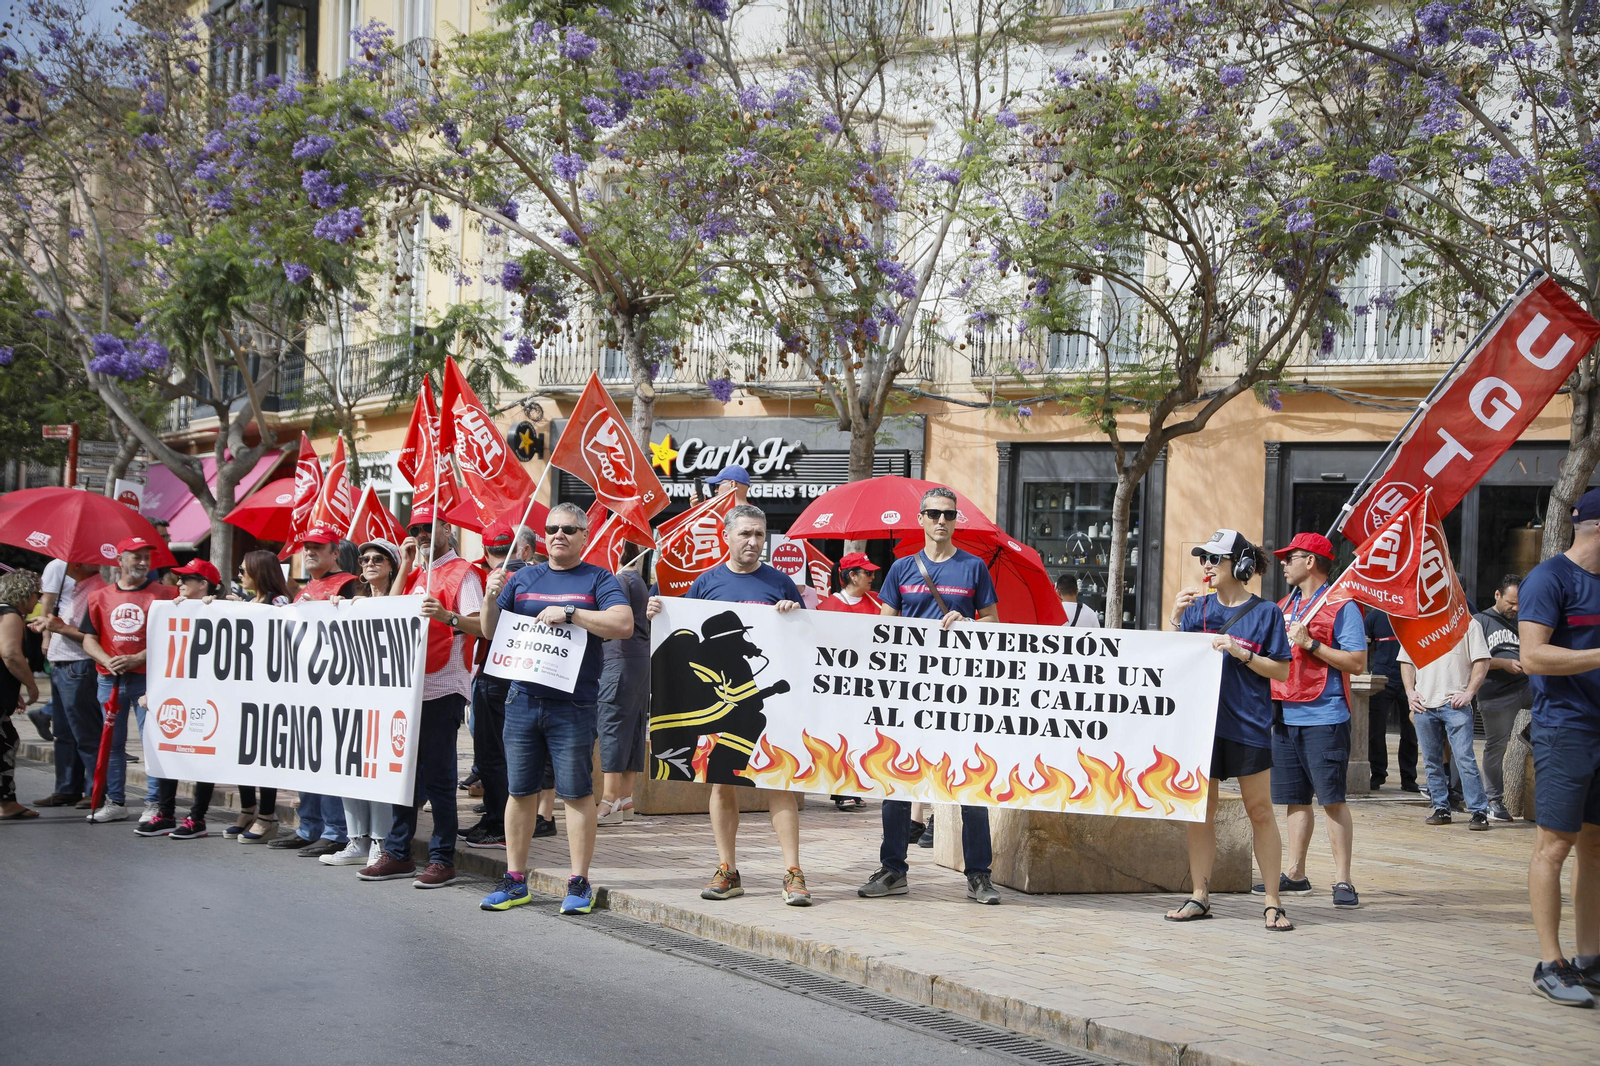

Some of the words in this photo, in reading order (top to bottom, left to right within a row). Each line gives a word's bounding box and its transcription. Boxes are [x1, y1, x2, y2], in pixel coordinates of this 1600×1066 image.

[462, 410, 503, 463] UGT
[676, 435, 754, 474] Carl's
[752, 437, 795, 475] Jr.
[799, 484, 837, 498] 194
[690, 517, 722, 561] UGT
[1339, 580, 1404, 605] www.ugt.es
[115, 608, 140, 620] UGT
[512, 621, 572, 641] JORNADA
[1417, 604, 1465, 649] www.ugt.es
[267, 617, 309, 684] UN
[506, 638, 521, 650] 35
[523, 641, 569, 658] HORAS
[873, 623, 928, 648] SIN
[938, 628, 1121, 658] INVERSIÓN
[492, 651, 522, 668] UGT
[816, 646, 858, 669] NO
[869, 650, 907, 674] SE
[918, 655, 1027, 681] PUEDE
[1037, 662, 1105, 685] DAR
[1118, 667, 1165, 689] UN
[160, 704, 184, 721] UGT
[812, 673, 968, 705] SERVICIO
[979, 685, 1020, 708] DE
[1030, 688, 1176, 717] CALIDAD
[238, 702, 323, 773] DIGNO
[332, 707, 380, 779] YA!!
[864, 706, 904, 729] AL
[914, 709, 1109, 741] CIUDADANO
